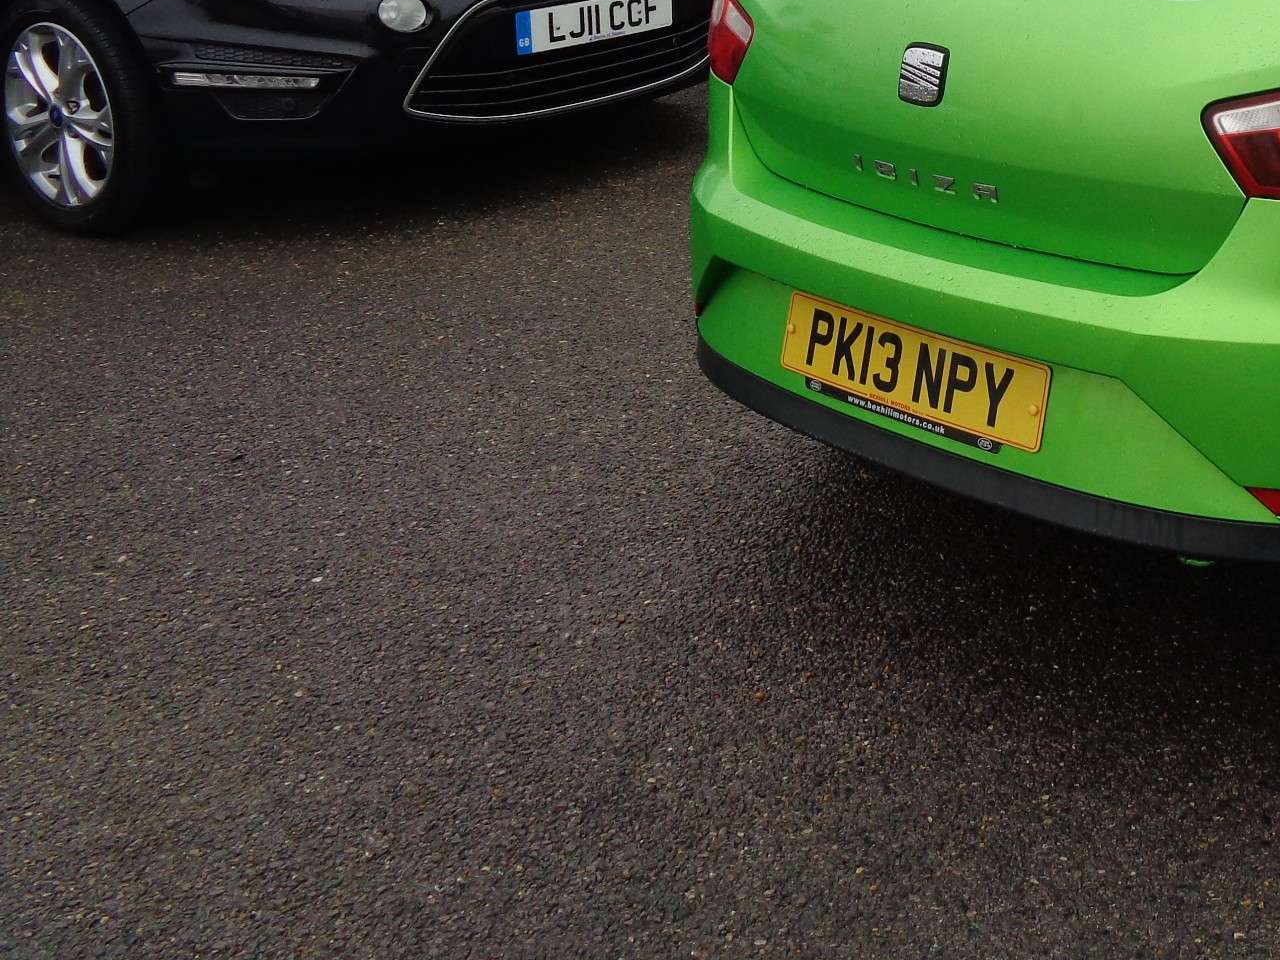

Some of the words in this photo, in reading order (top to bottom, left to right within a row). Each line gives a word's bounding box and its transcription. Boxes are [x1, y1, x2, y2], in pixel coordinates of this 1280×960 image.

[519, 38, 530, 48] GB
[548, 4, 601, 44] LJ11
[852, 153, 1000, 205] IBIZA
[805, 308, 903, 394] PK13
[911, 342, 1015, 428] NPY
[847, 395, 946, 436] www.bexhillmotors.co.uk
